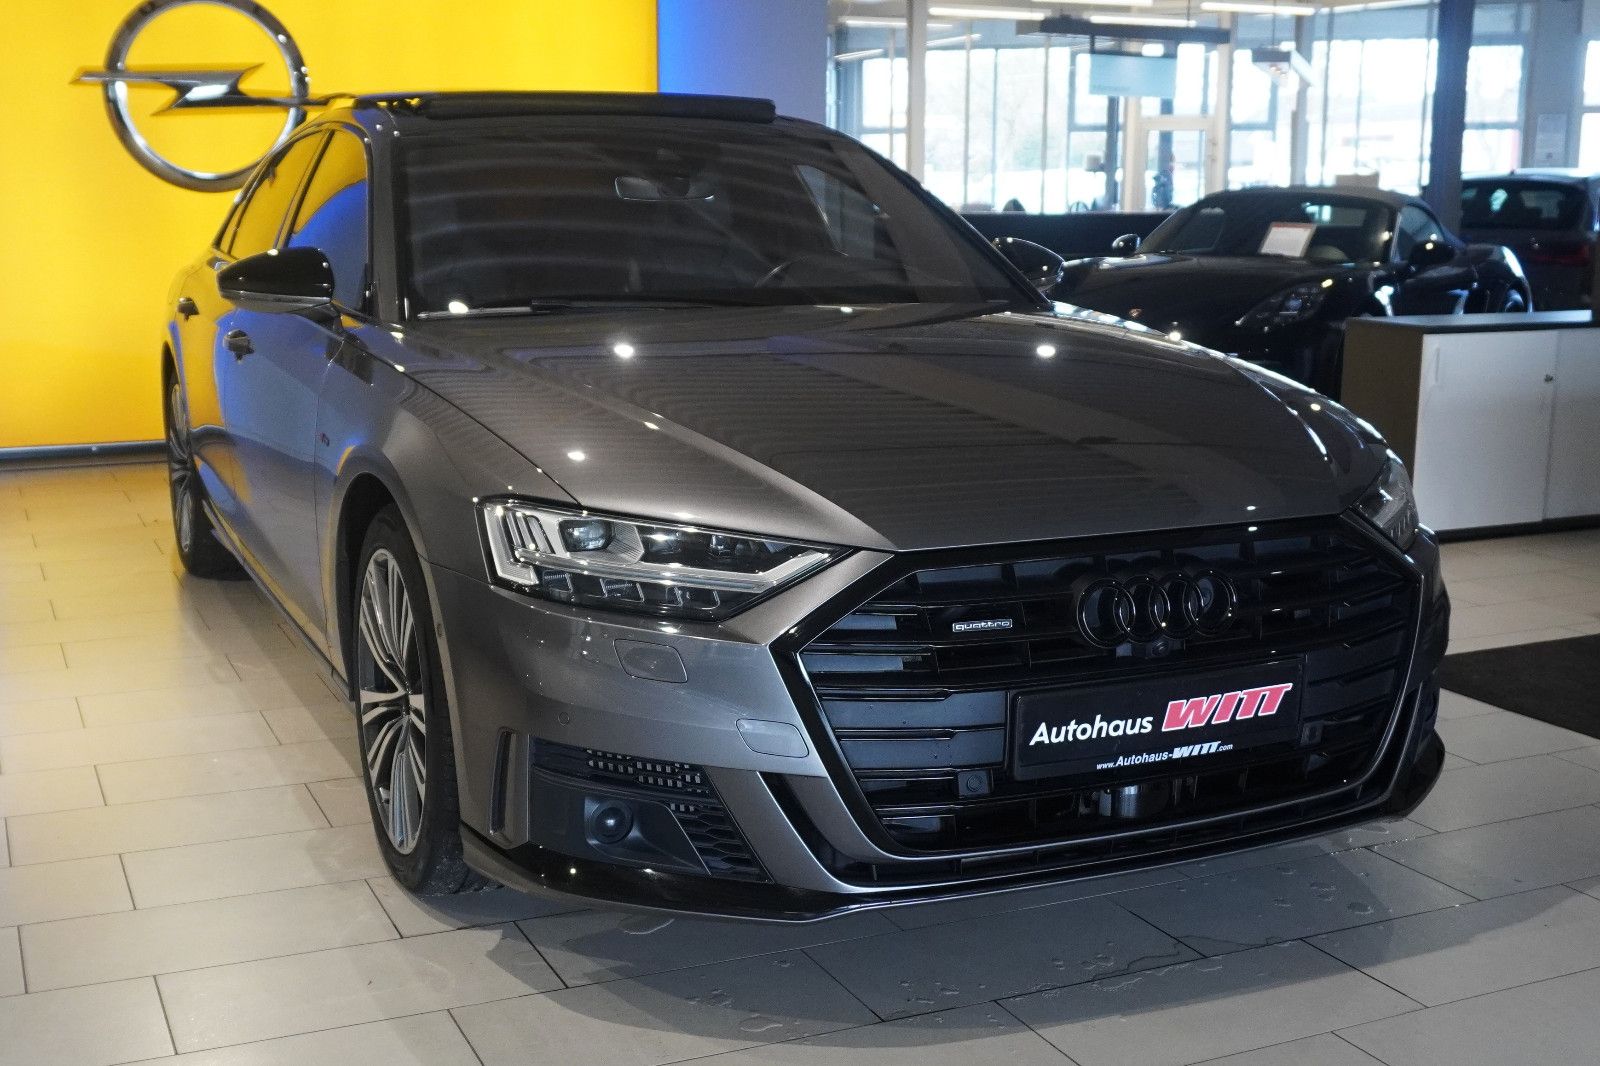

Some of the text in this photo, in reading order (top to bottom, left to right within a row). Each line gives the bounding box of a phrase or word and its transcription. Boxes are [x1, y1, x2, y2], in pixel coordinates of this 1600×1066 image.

[955, 621, 1010, 631] quattro
[1029, 683, 1293, 746] Autohaus WITT
[1096, 741, 1234, 770] www.Autohaus-WITT.com
